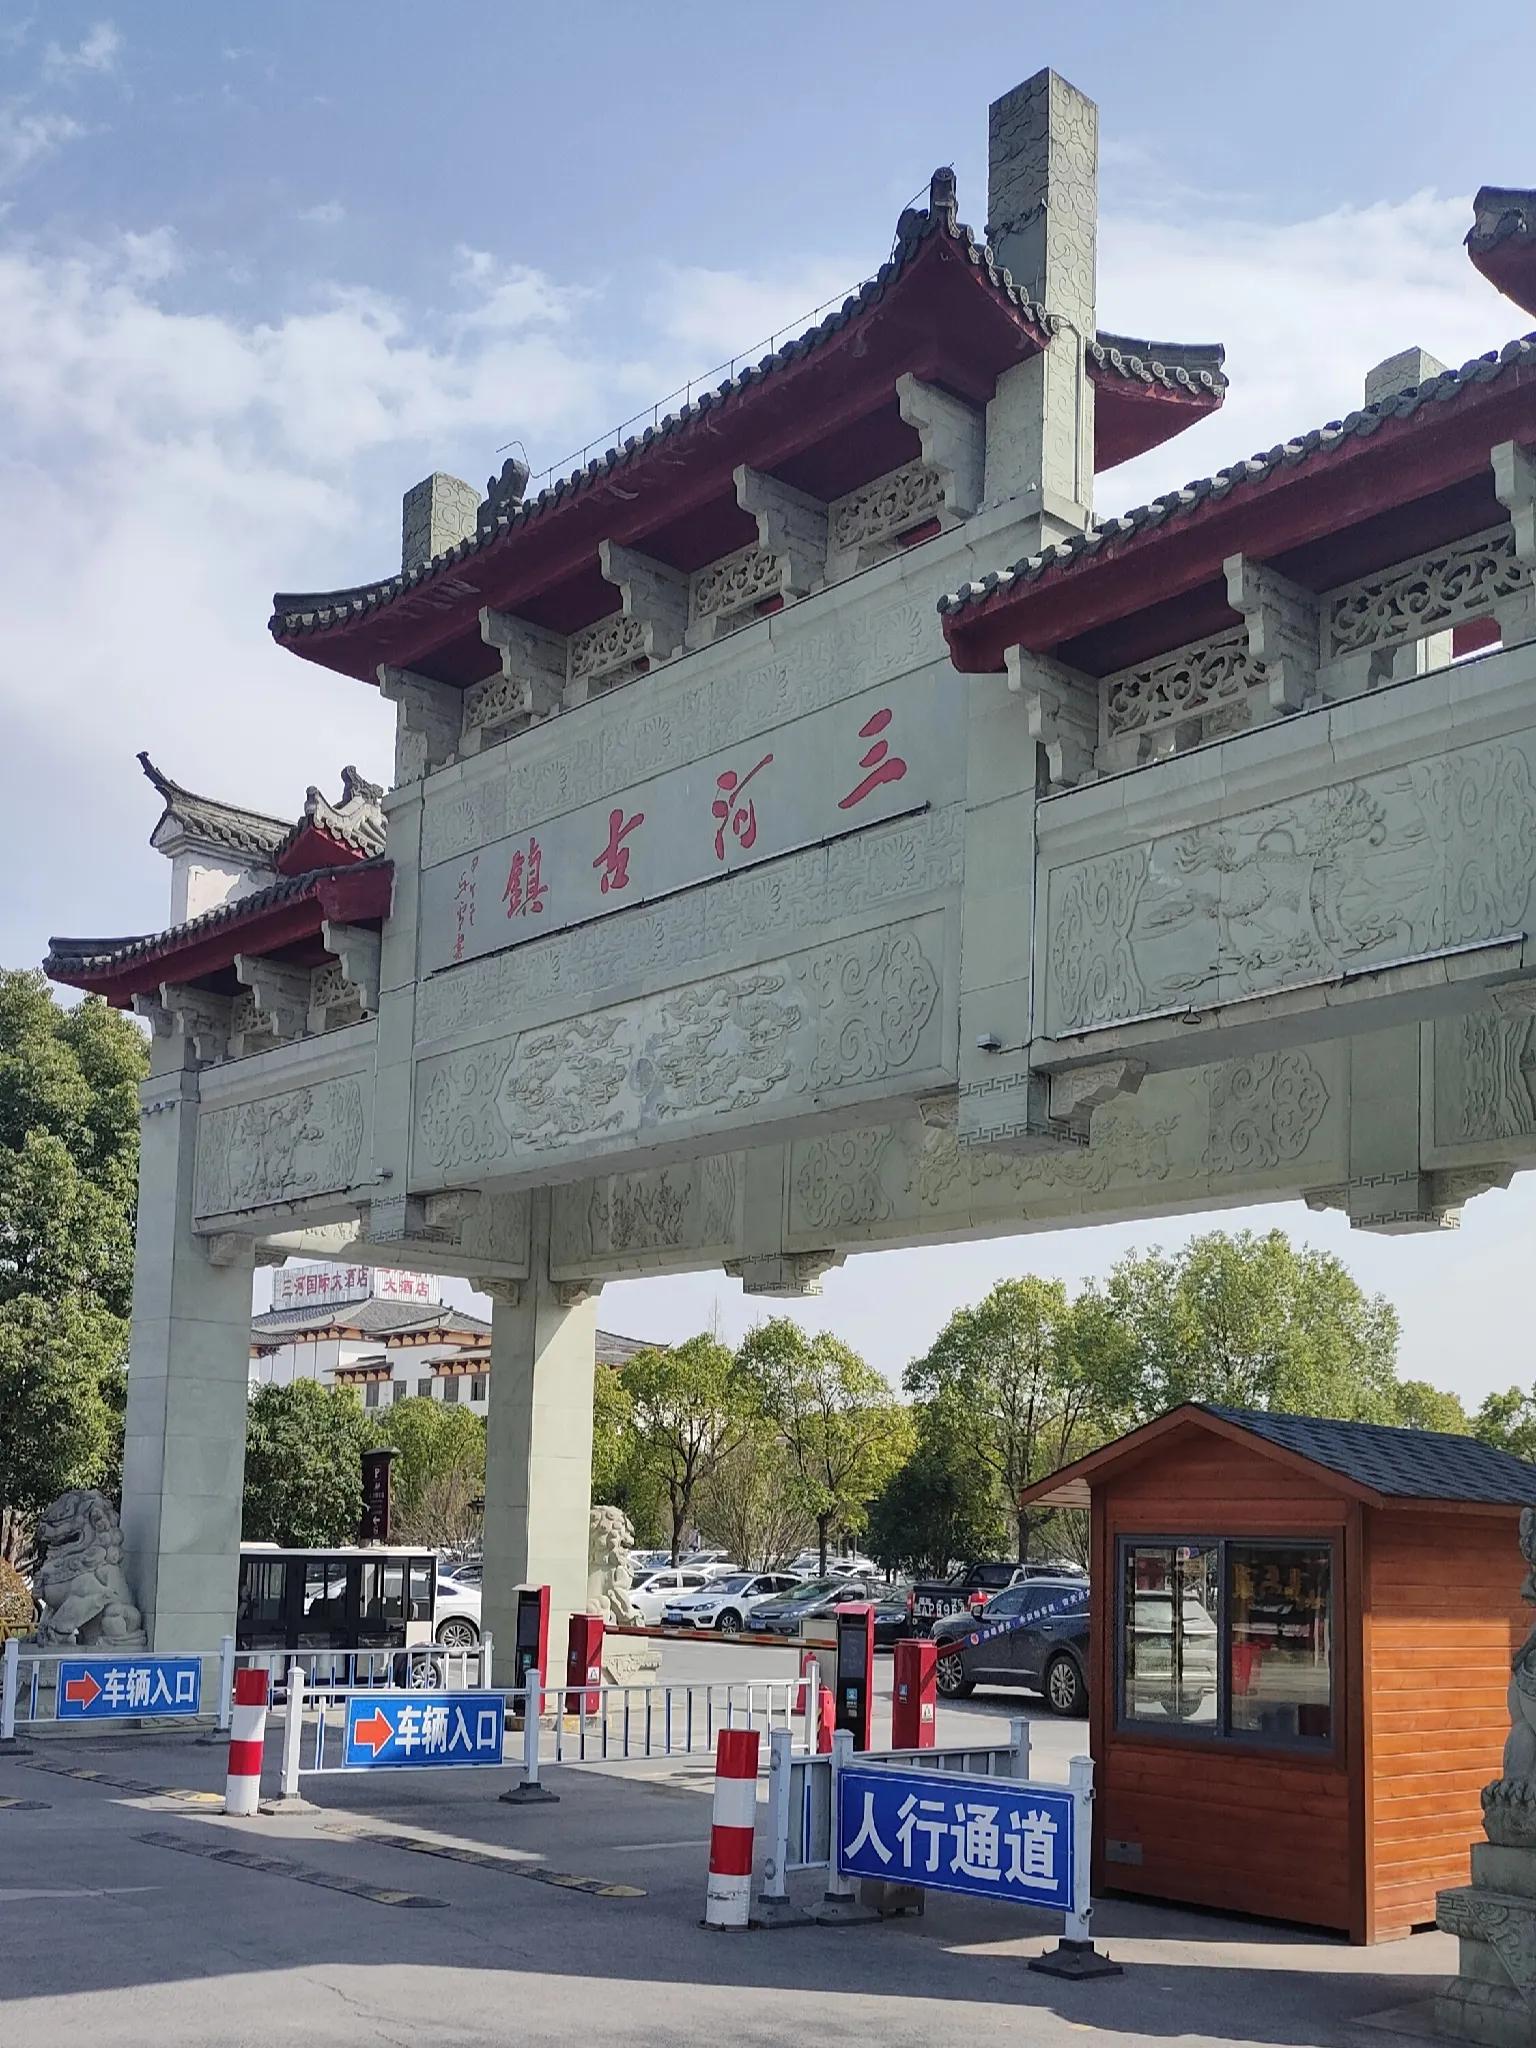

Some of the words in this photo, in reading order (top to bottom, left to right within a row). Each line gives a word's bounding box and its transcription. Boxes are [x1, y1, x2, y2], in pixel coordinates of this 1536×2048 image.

[282, 1265, 369, 1298] 三河国际大酒店
[102, 1665, 196, 1709] 车辆入口
[395, 1704, 498, 1756] 车辆入口
[843, 1790, 1060, 1891] 人行通道
